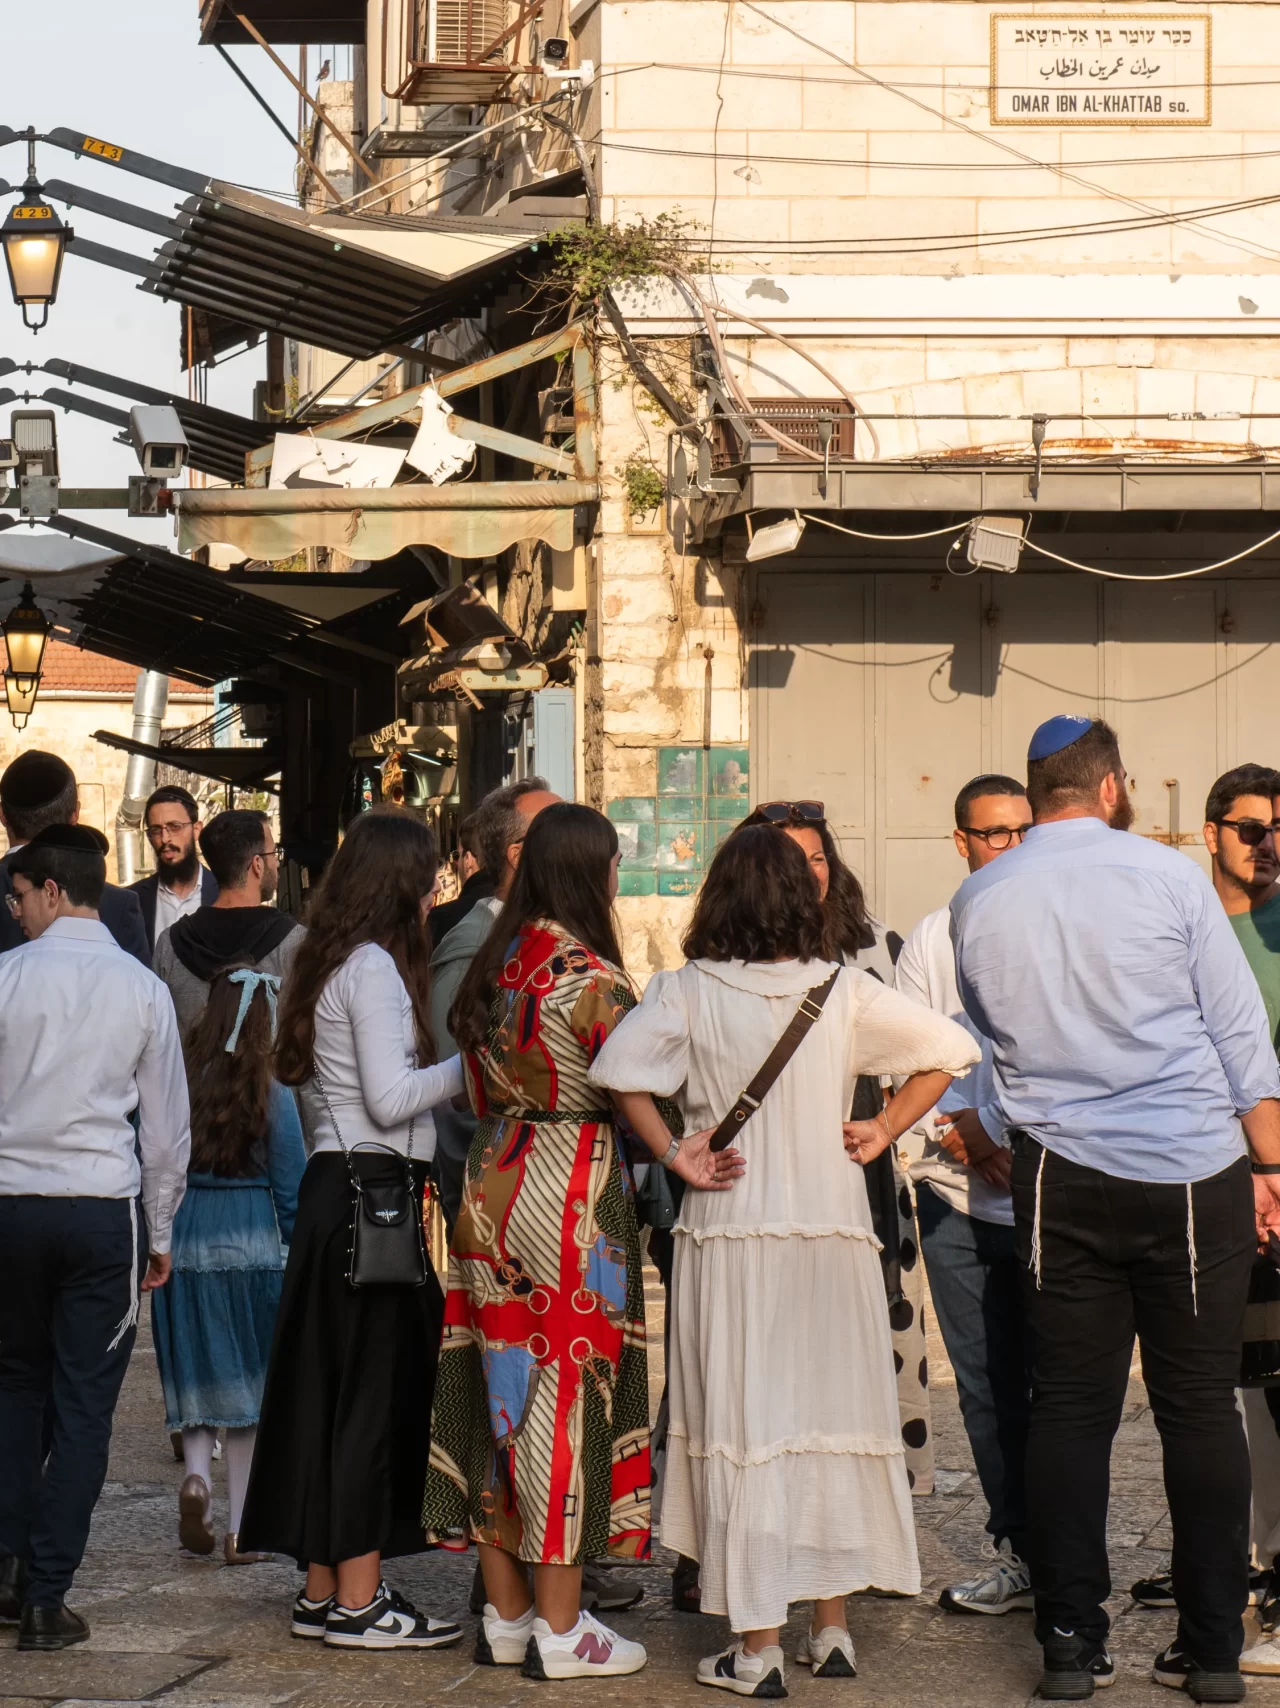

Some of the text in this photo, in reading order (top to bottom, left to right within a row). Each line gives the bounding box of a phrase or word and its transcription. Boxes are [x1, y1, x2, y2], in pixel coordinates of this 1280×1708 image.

[1039, 57, 1083, 81] الخطاب
[1130, 57, 1161, 79] ميدان
[1012, 95, 1050, 113] OMAR
[1056, 95, 1077, 113] IBN
[1083, 95, 1162, 113] AL-KHATTAB
[86, 138, 119, 160] 713
[15, 207, 50, 218] 429
